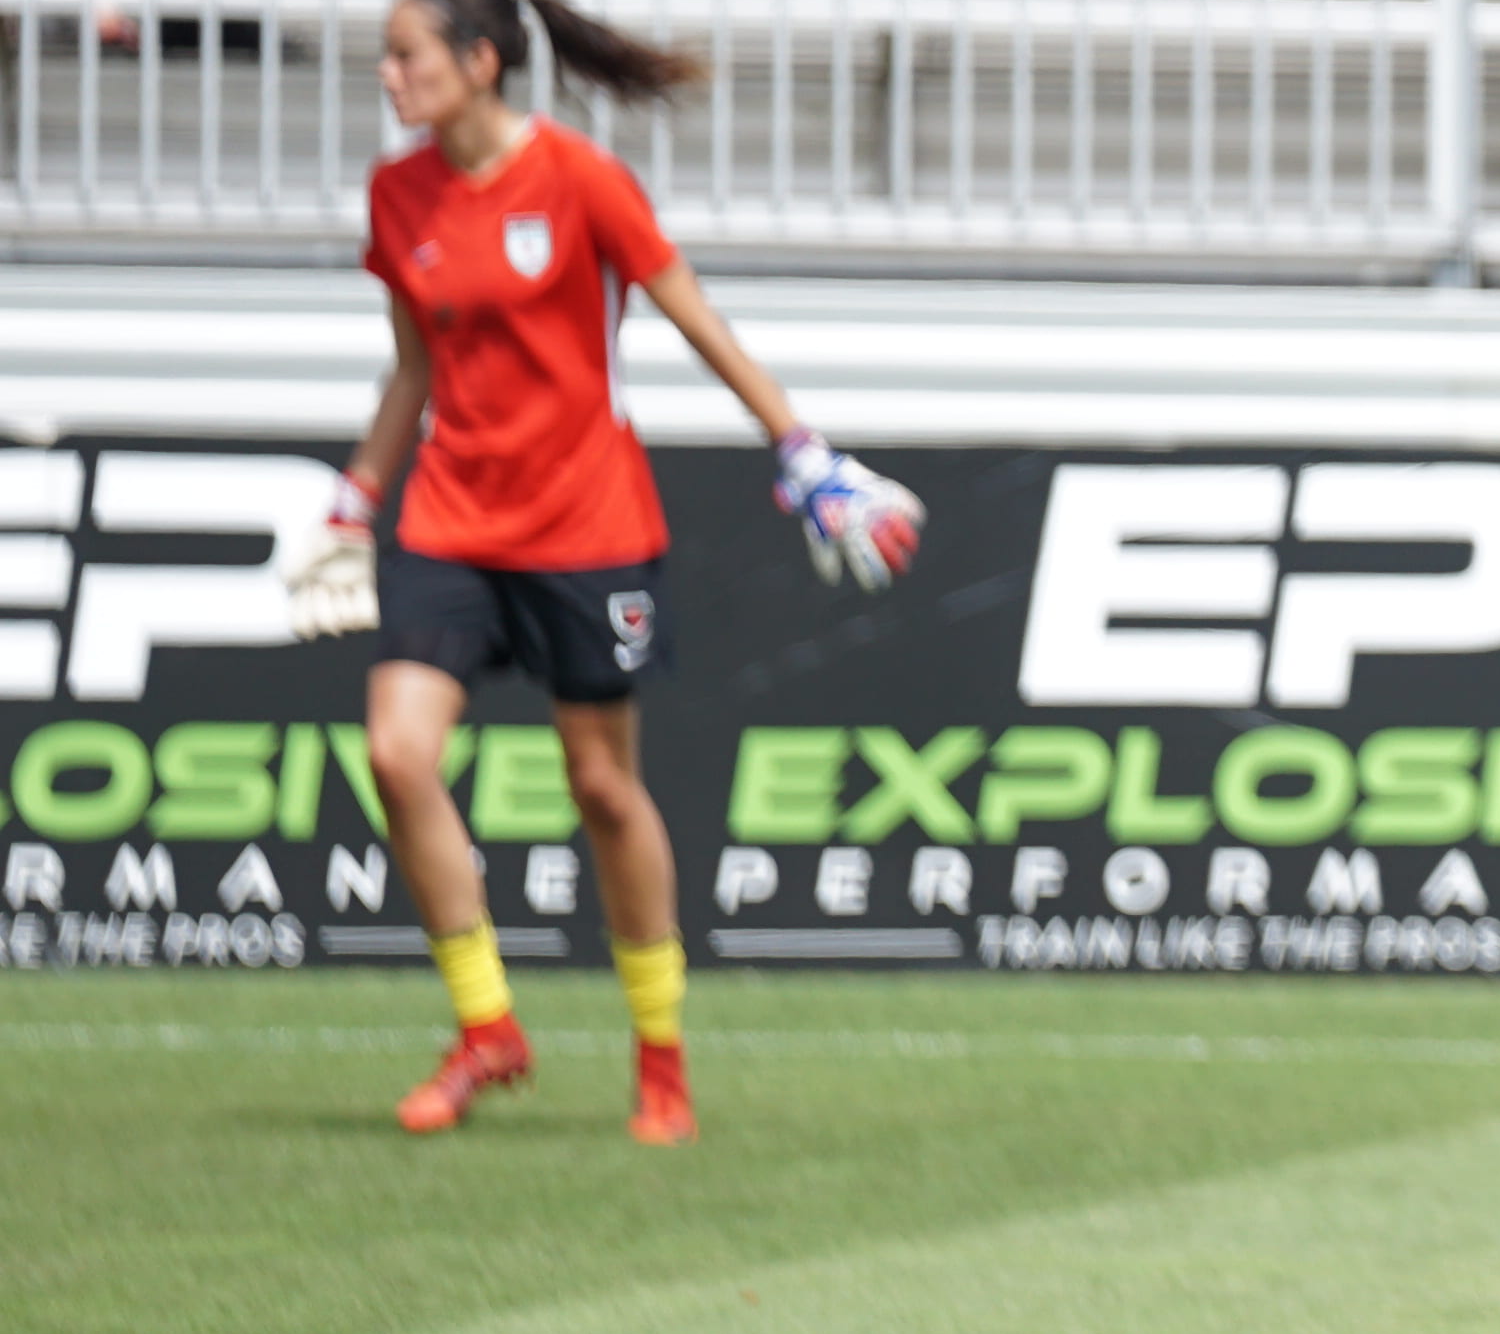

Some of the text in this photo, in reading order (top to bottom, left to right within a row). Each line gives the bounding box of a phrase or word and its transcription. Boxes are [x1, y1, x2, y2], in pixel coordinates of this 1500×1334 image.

[0, 720, 583, 843] OSIVE
[2, 841, 580, 915] RMANE
[54, 911, 160, 968] THE
[162, 912, 307, 968] PROS
[977, 914, 1133, 970] TRAIN
[1136, 914, 1253, 970] LIKE
[1257, 914, 1363, 971] THE
